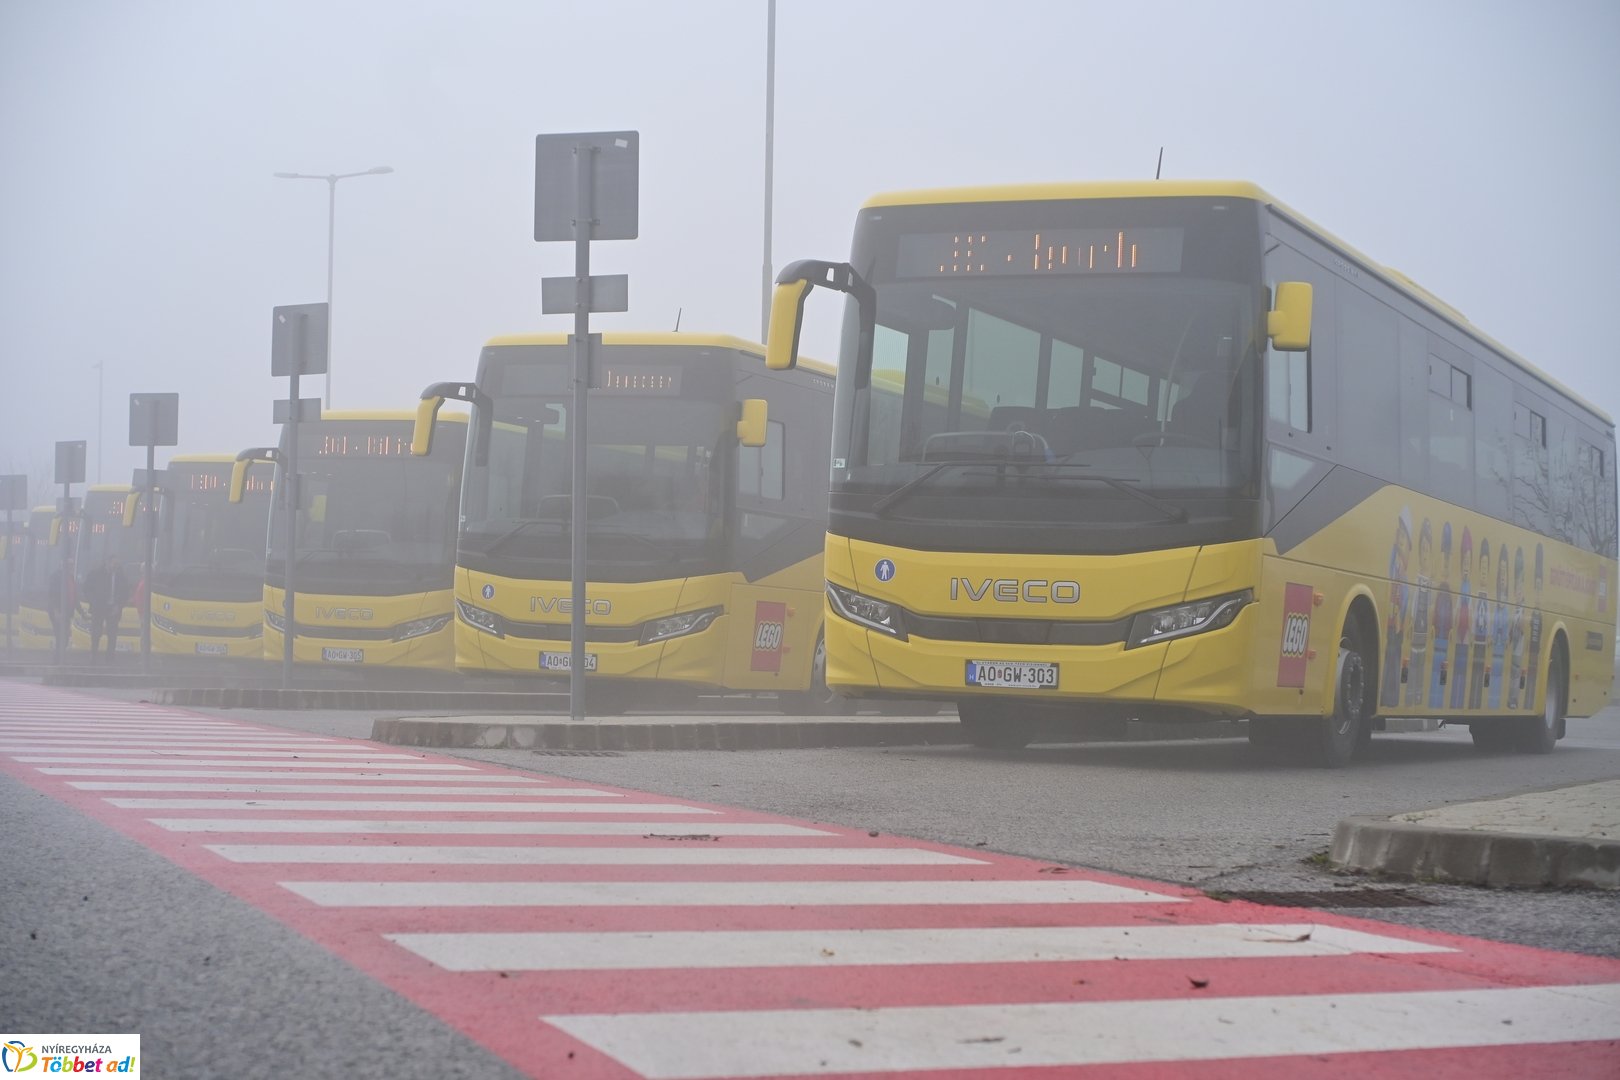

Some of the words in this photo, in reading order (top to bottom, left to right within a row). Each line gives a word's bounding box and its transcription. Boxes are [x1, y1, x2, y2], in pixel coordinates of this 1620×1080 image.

[950, 577, 1080, 604] IVECO
[315, 607, 374, 620] IVECO
[754, 622, 783, 650] LEGO
[1282, 613, 1308, 656] LEGO
